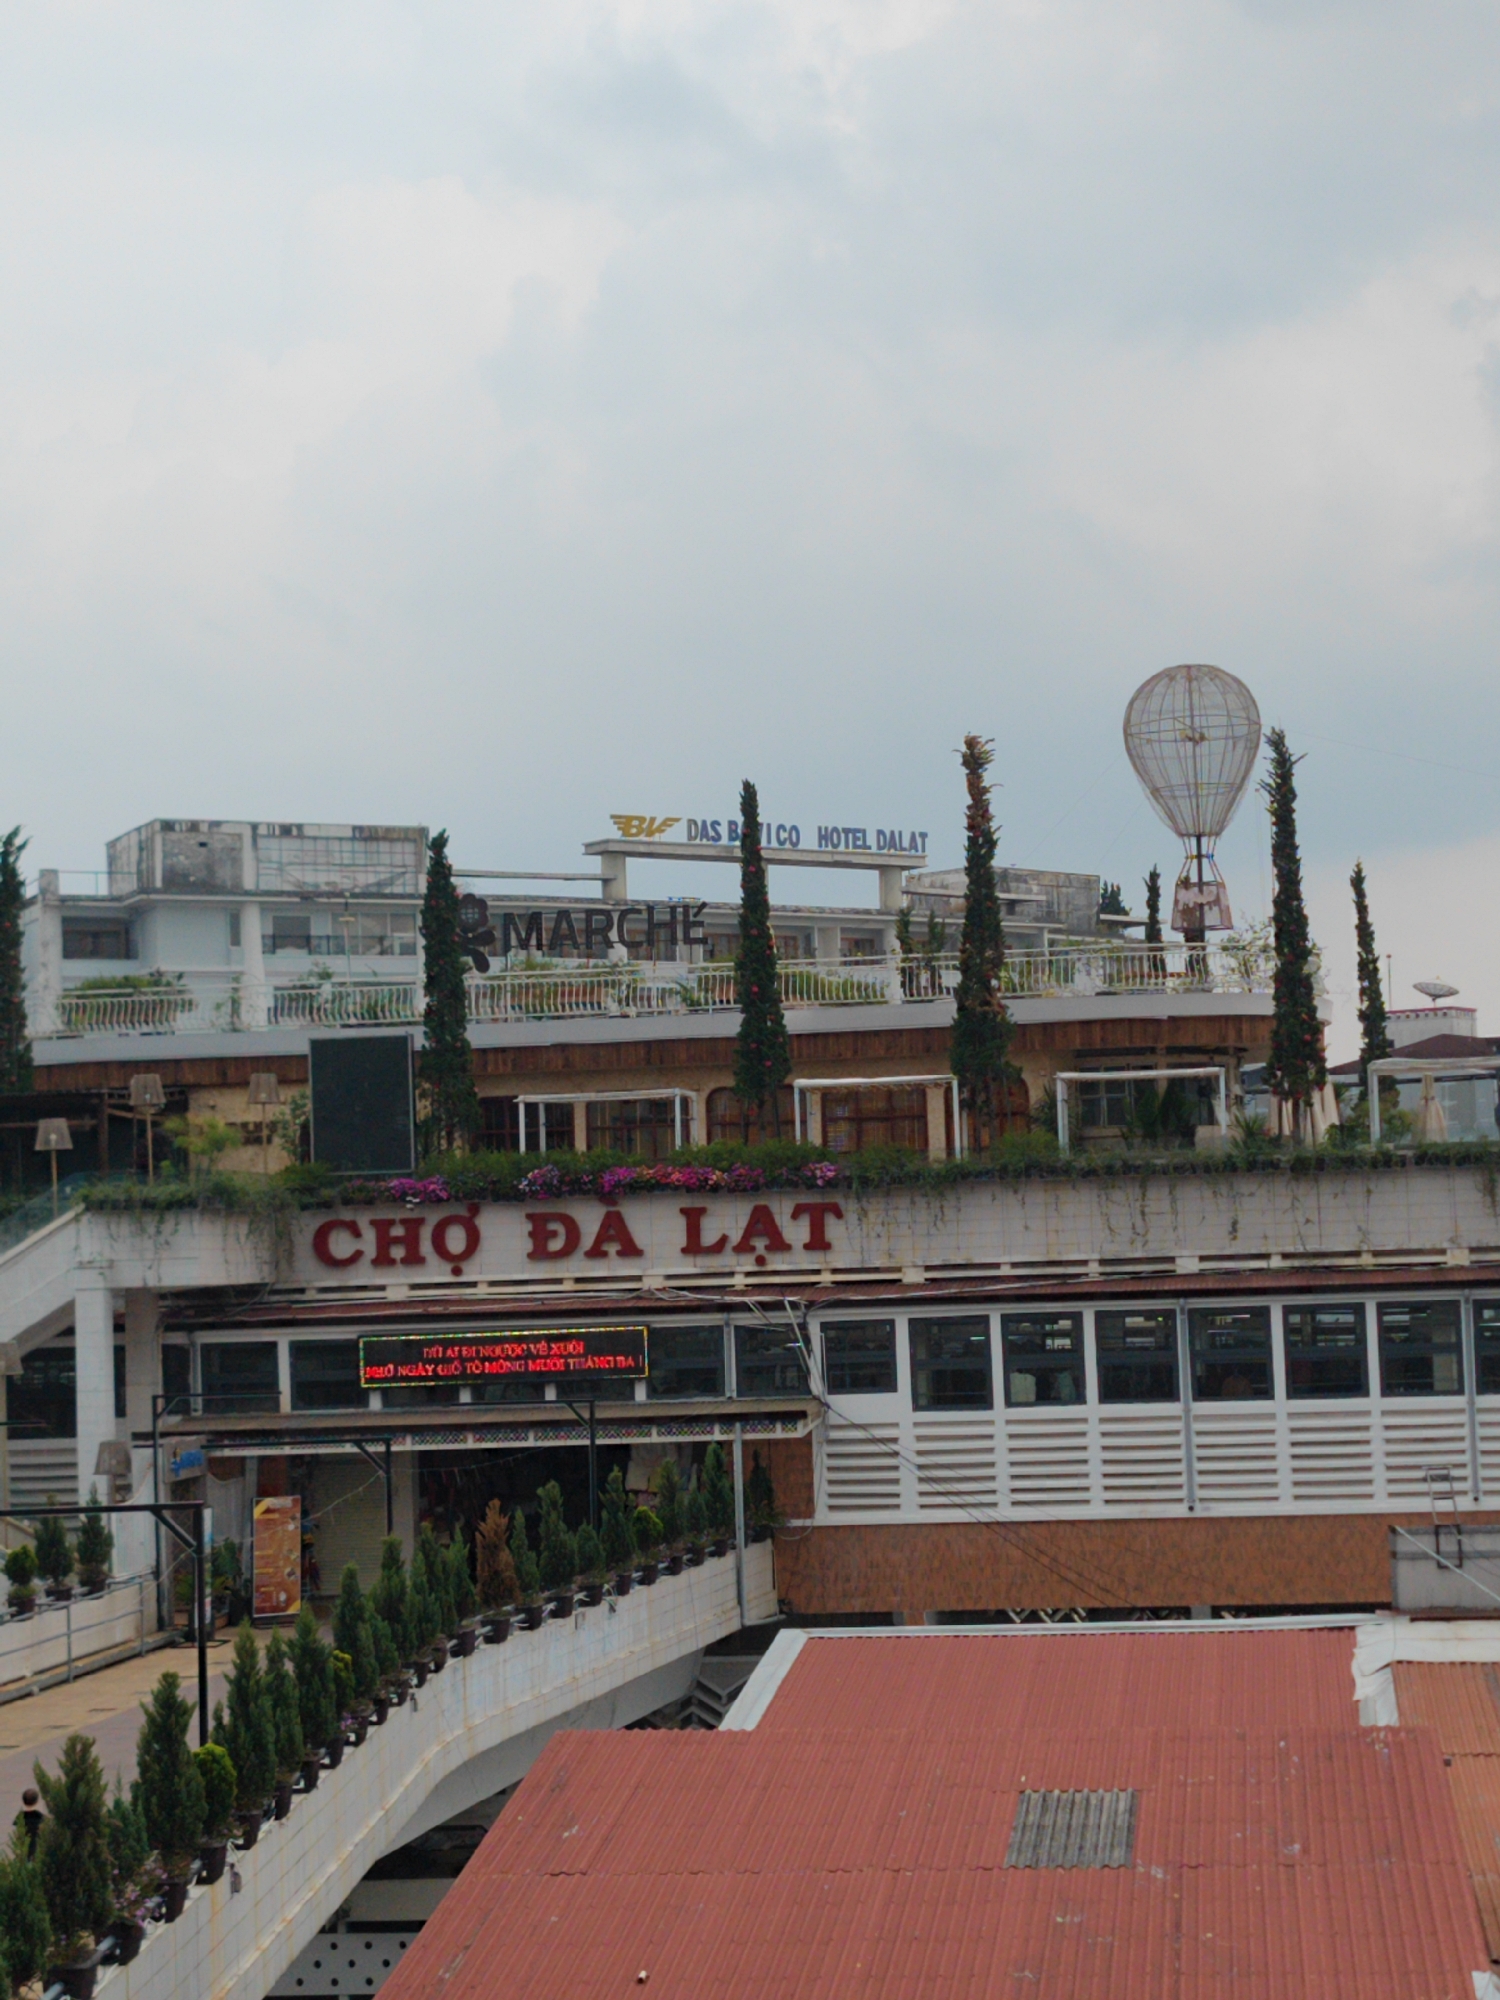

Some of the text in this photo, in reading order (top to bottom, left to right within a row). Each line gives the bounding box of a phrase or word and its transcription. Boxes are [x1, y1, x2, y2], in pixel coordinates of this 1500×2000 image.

[687, 818, 722, 843] DAS
[817, 825, 872, 851] HOTEL
[876, 829, 929, 853] DALAT
[503, 901, 709, 953] MARCHÉ
[312, 1195, 844, 1277] CHỢ ĐÀ LẠT
